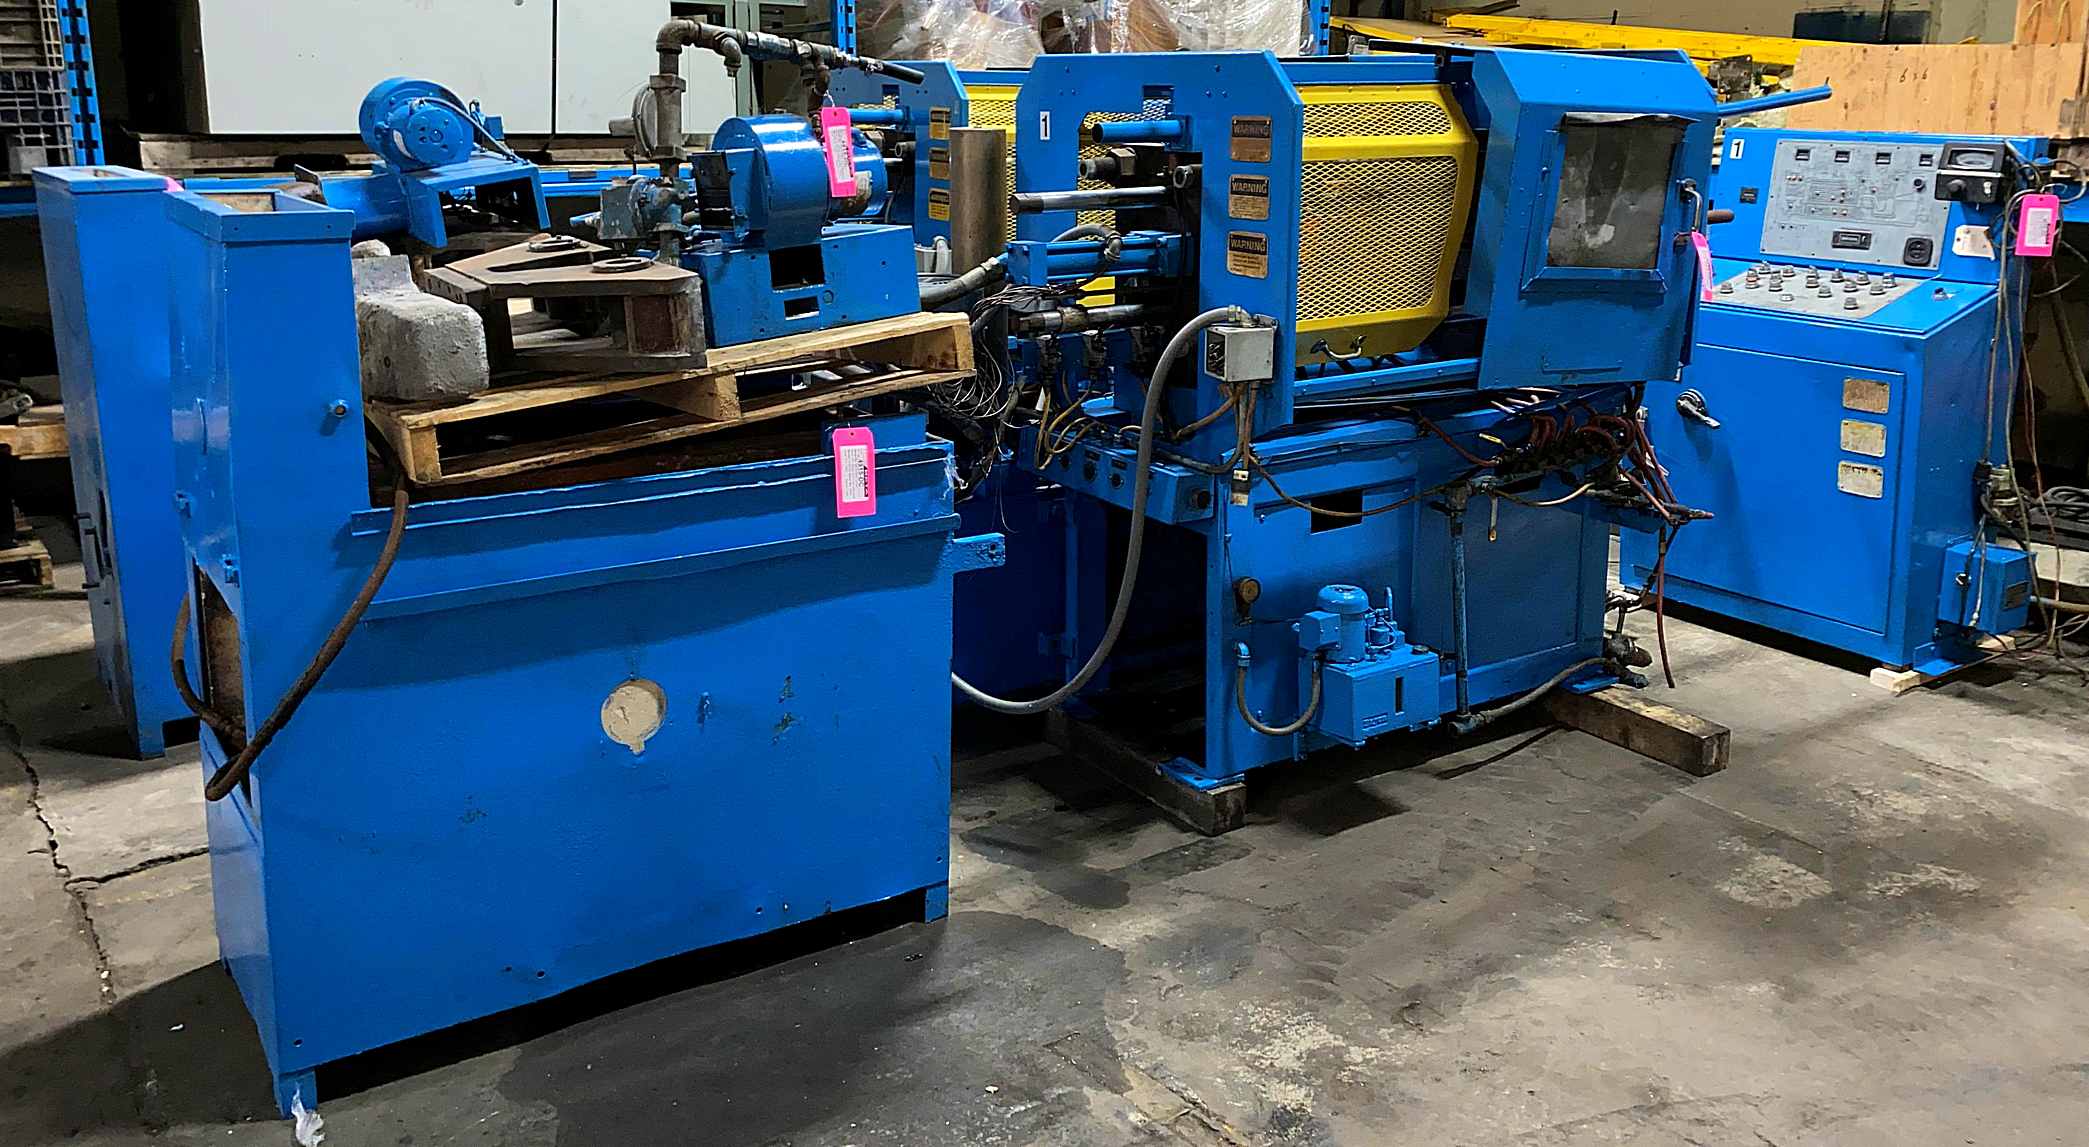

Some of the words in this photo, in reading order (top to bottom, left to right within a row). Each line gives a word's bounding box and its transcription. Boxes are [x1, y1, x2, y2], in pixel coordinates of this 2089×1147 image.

[1041, 115, 1048, 137] 1
[1233, 124, 1269, 137] WARNING
[1733, 141, 1741, 157] 1
[1232, 181, 1267, 193] WARNING
[1231, 239, 1266, 251] WARNING
